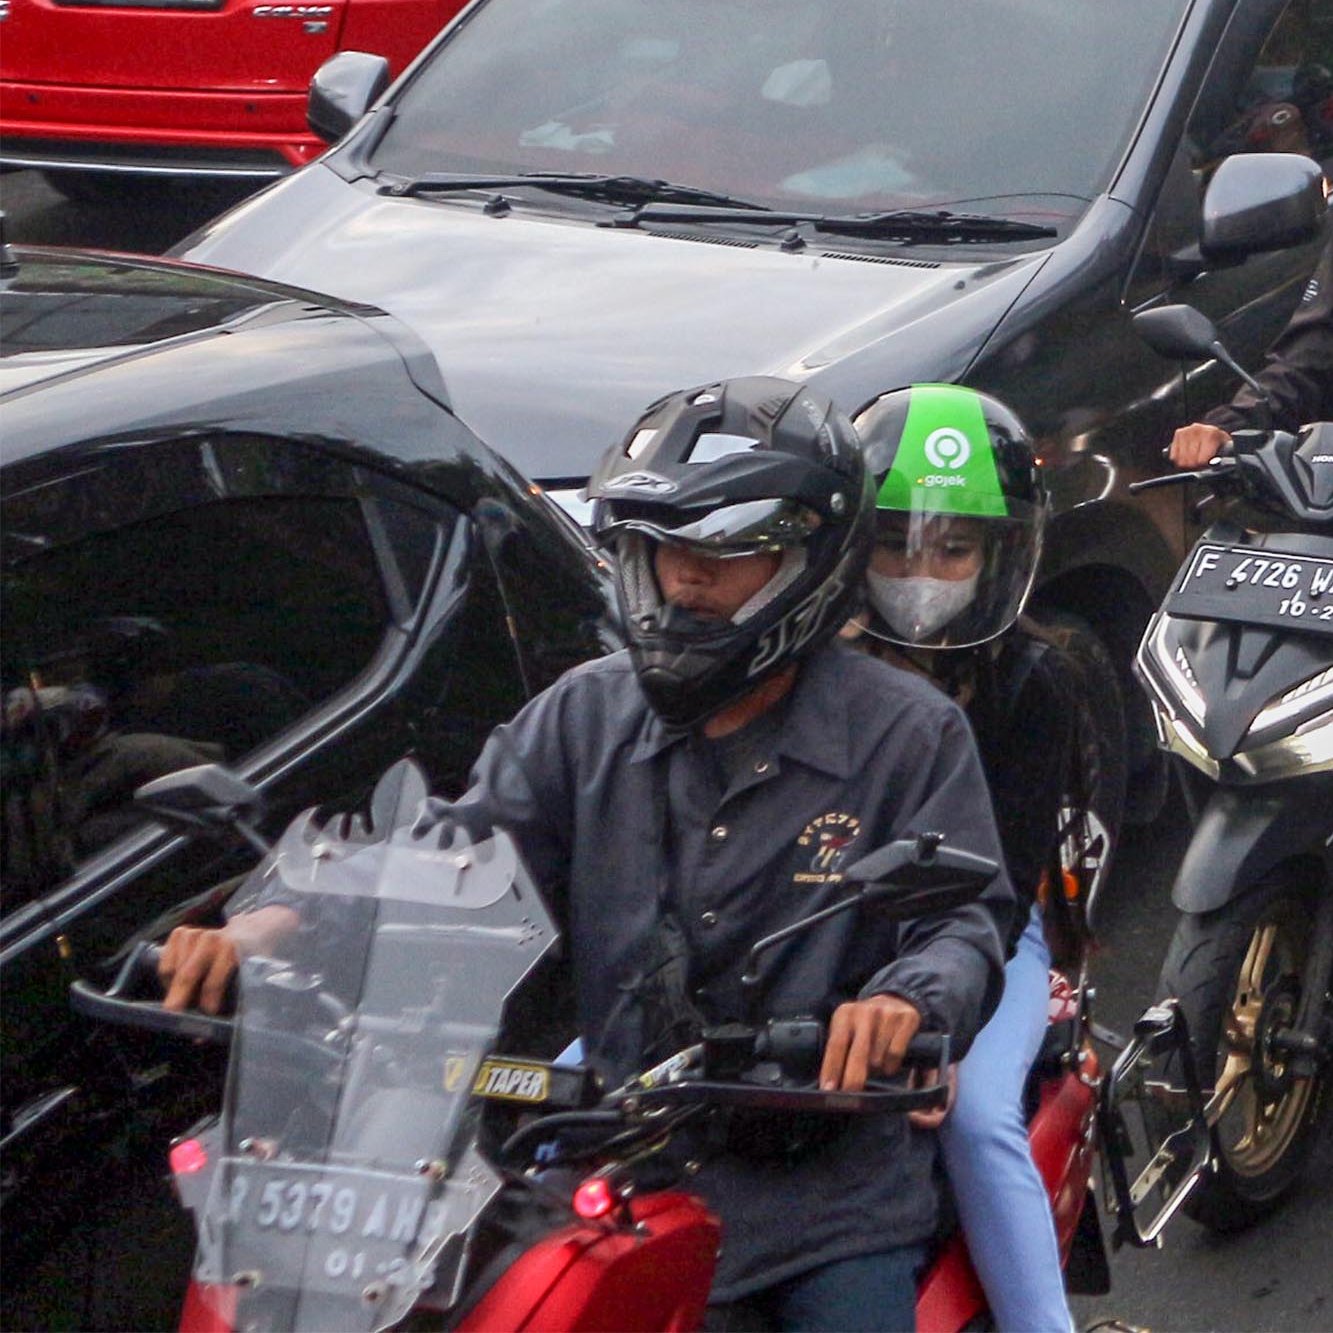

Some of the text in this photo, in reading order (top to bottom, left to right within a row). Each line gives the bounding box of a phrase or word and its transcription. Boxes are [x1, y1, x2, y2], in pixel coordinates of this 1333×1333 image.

[924, 474, 966, 488] gojek
[1197, 553, 1220, 578] F
[1230, 559, 1302, 589] 4726
